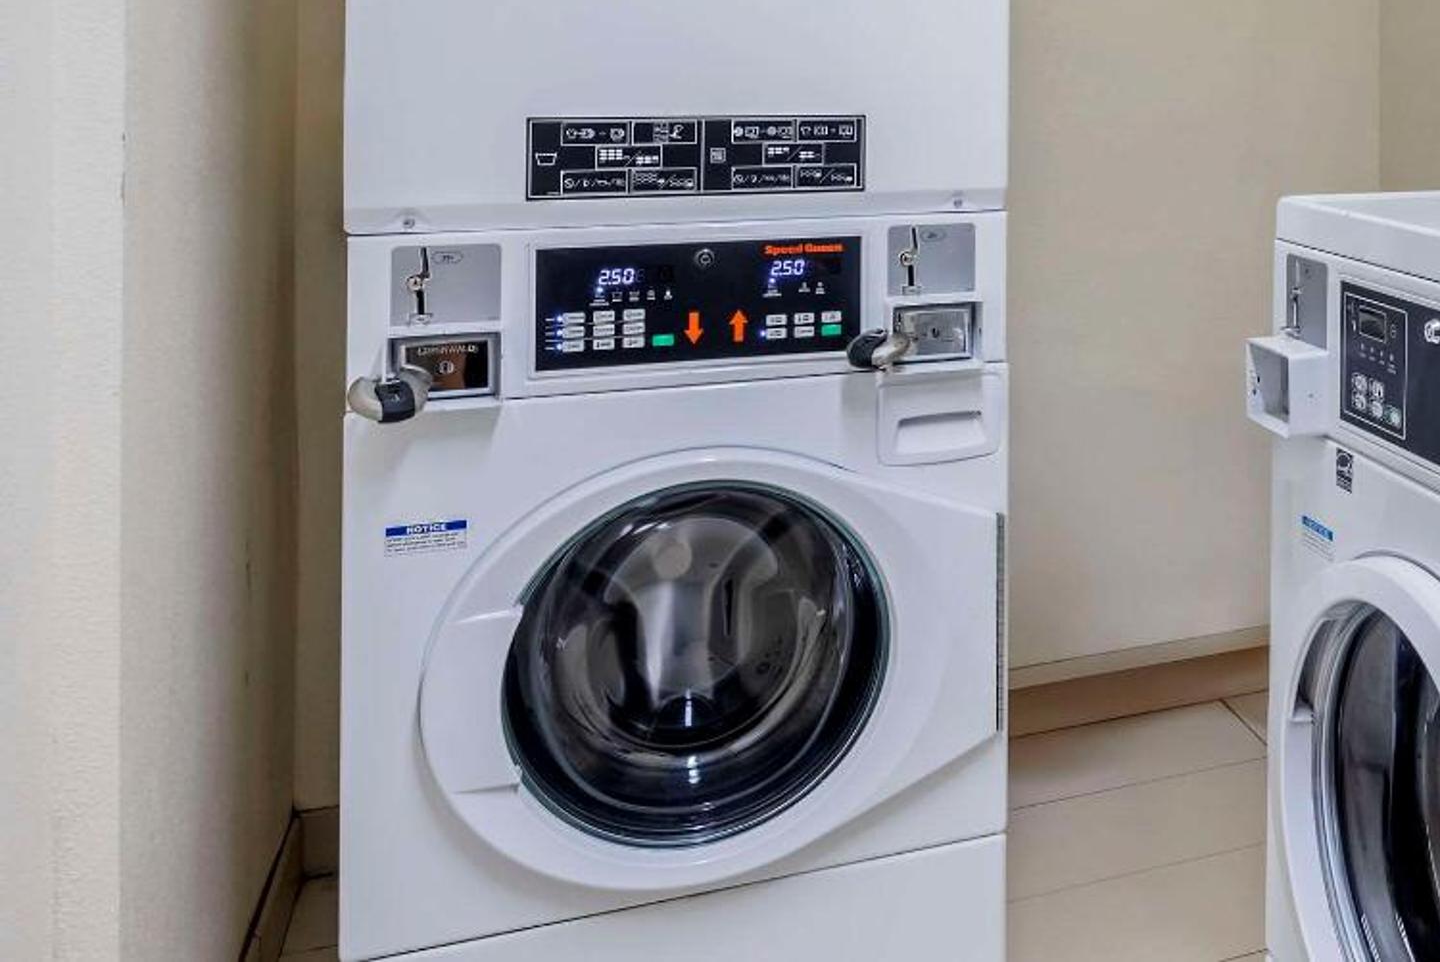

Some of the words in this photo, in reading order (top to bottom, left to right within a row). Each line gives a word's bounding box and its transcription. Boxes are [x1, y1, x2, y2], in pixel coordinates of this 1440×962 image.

[764, 244, 803, 256] Speed
[804, 242, 843, 253] Queen
[406, 523, 447, 535] NOTICE
